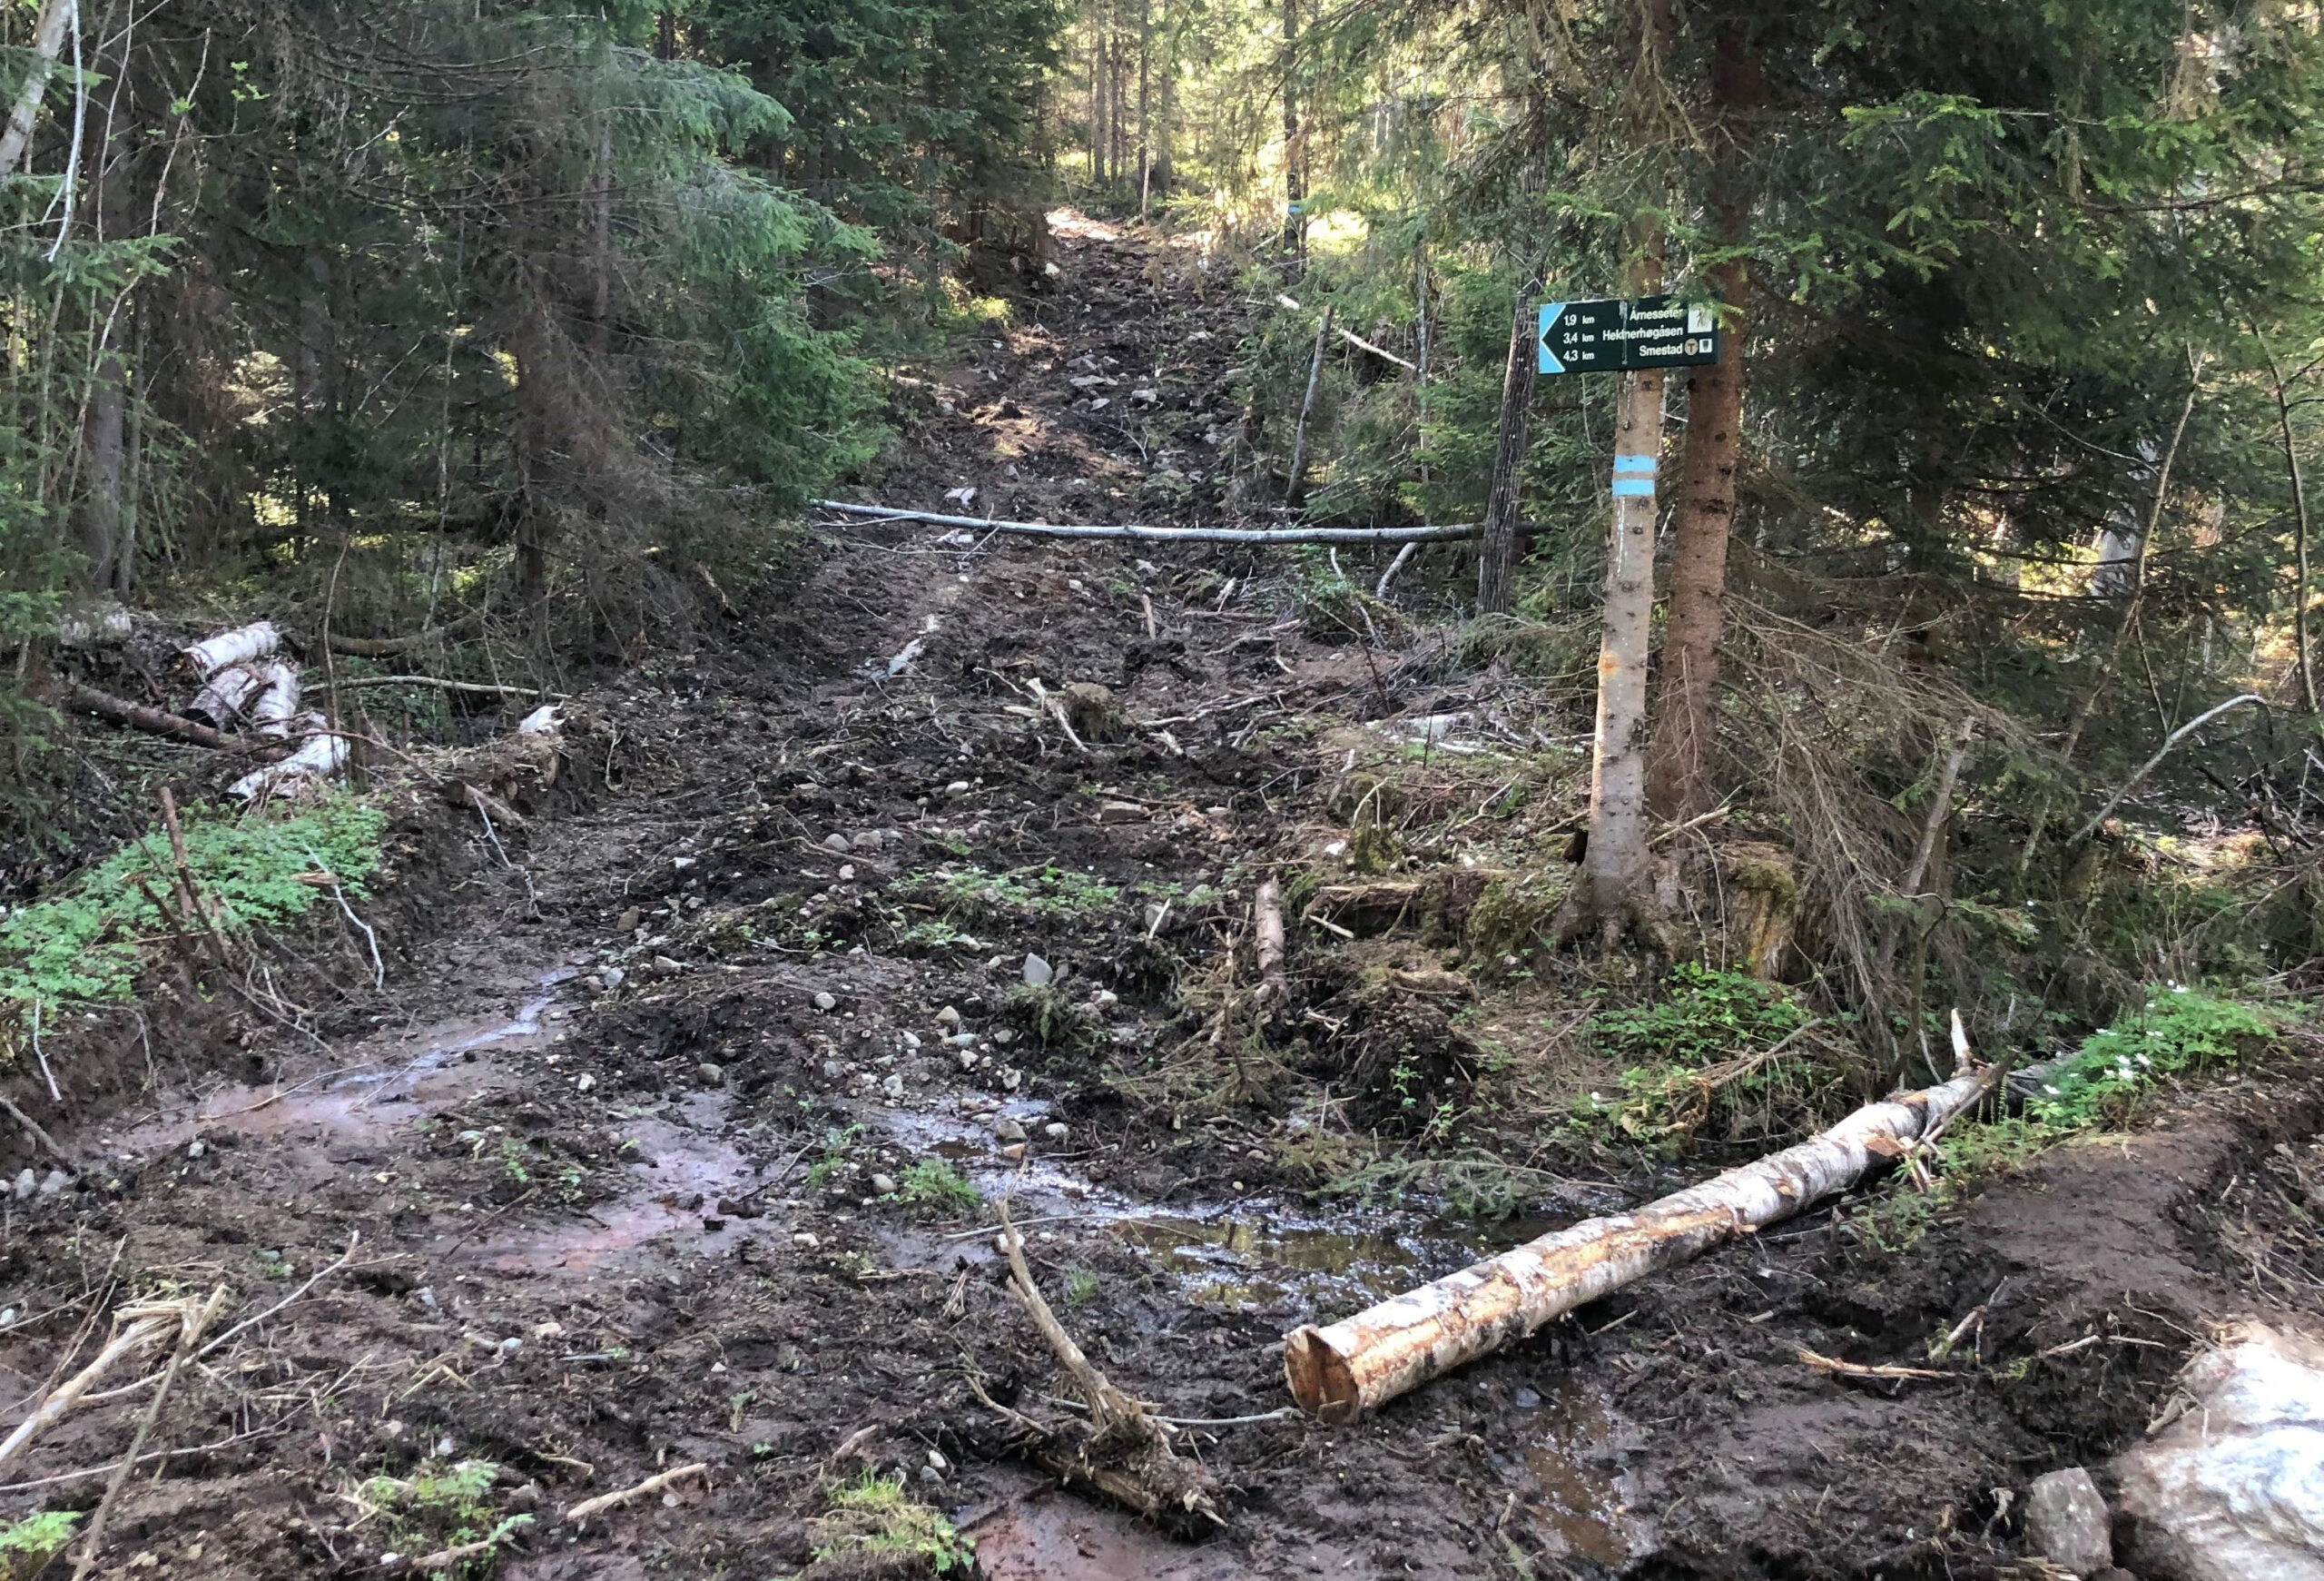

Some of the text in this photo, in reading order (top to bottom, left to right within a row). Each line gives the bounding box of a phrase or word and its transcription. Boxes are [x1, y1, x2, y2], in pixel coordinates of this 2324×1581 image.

[1563, 314, 1577, 326] 1,9
[1582, 314, 1595, 323] km
[1563, 325, 1683, 343] 3,4 km Hektnerhøgåsen
[1563, 351, 1578, 361] 4,3
[1582, 351, 1595, 360] km
[1640, 343, 1683, 356] Smestad
